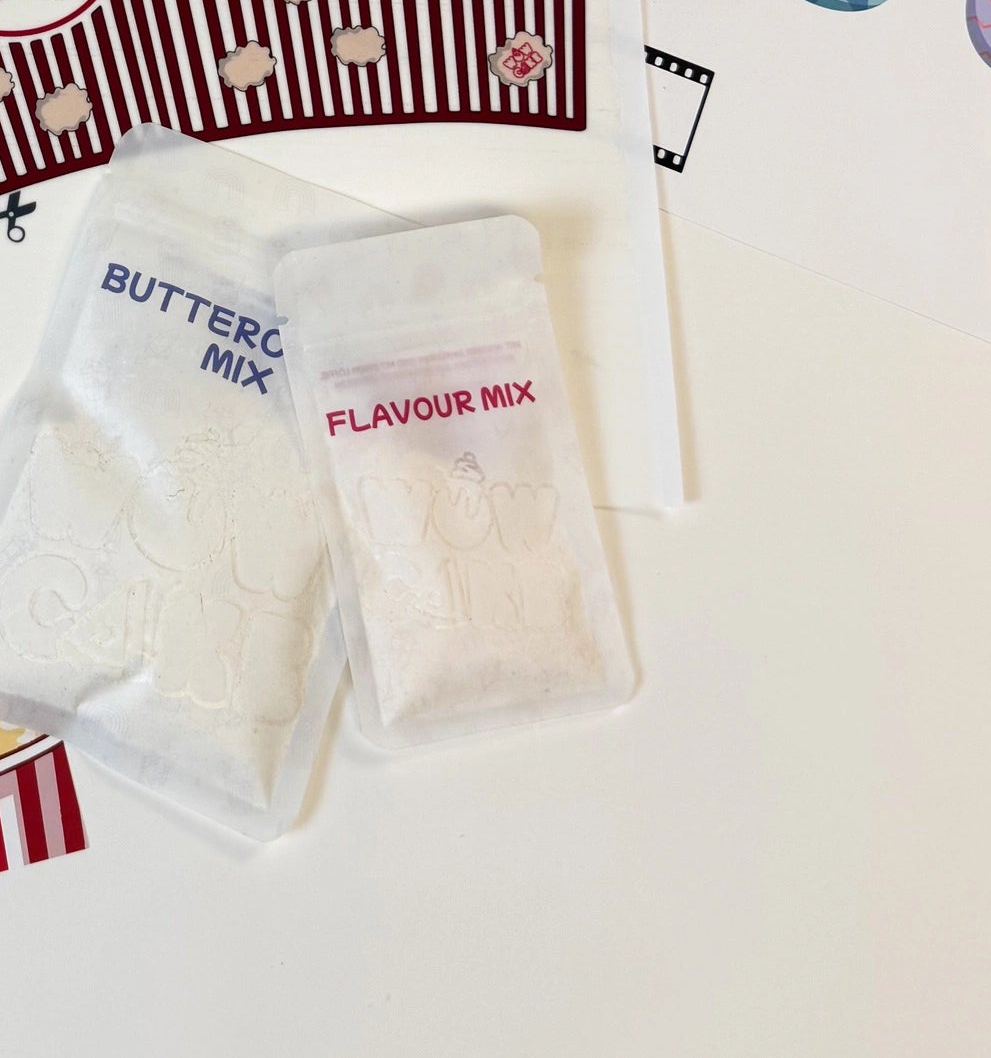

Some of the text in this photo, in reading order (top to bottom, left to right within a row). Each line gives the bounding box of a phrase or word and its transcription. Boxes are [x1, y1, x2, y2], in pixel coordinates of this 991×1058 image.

[100, 262, 284, 359] BUTTERC
[200, 342, 274, 395] MIX
[326, 379, 536, 436] FLAVOUR MIX
